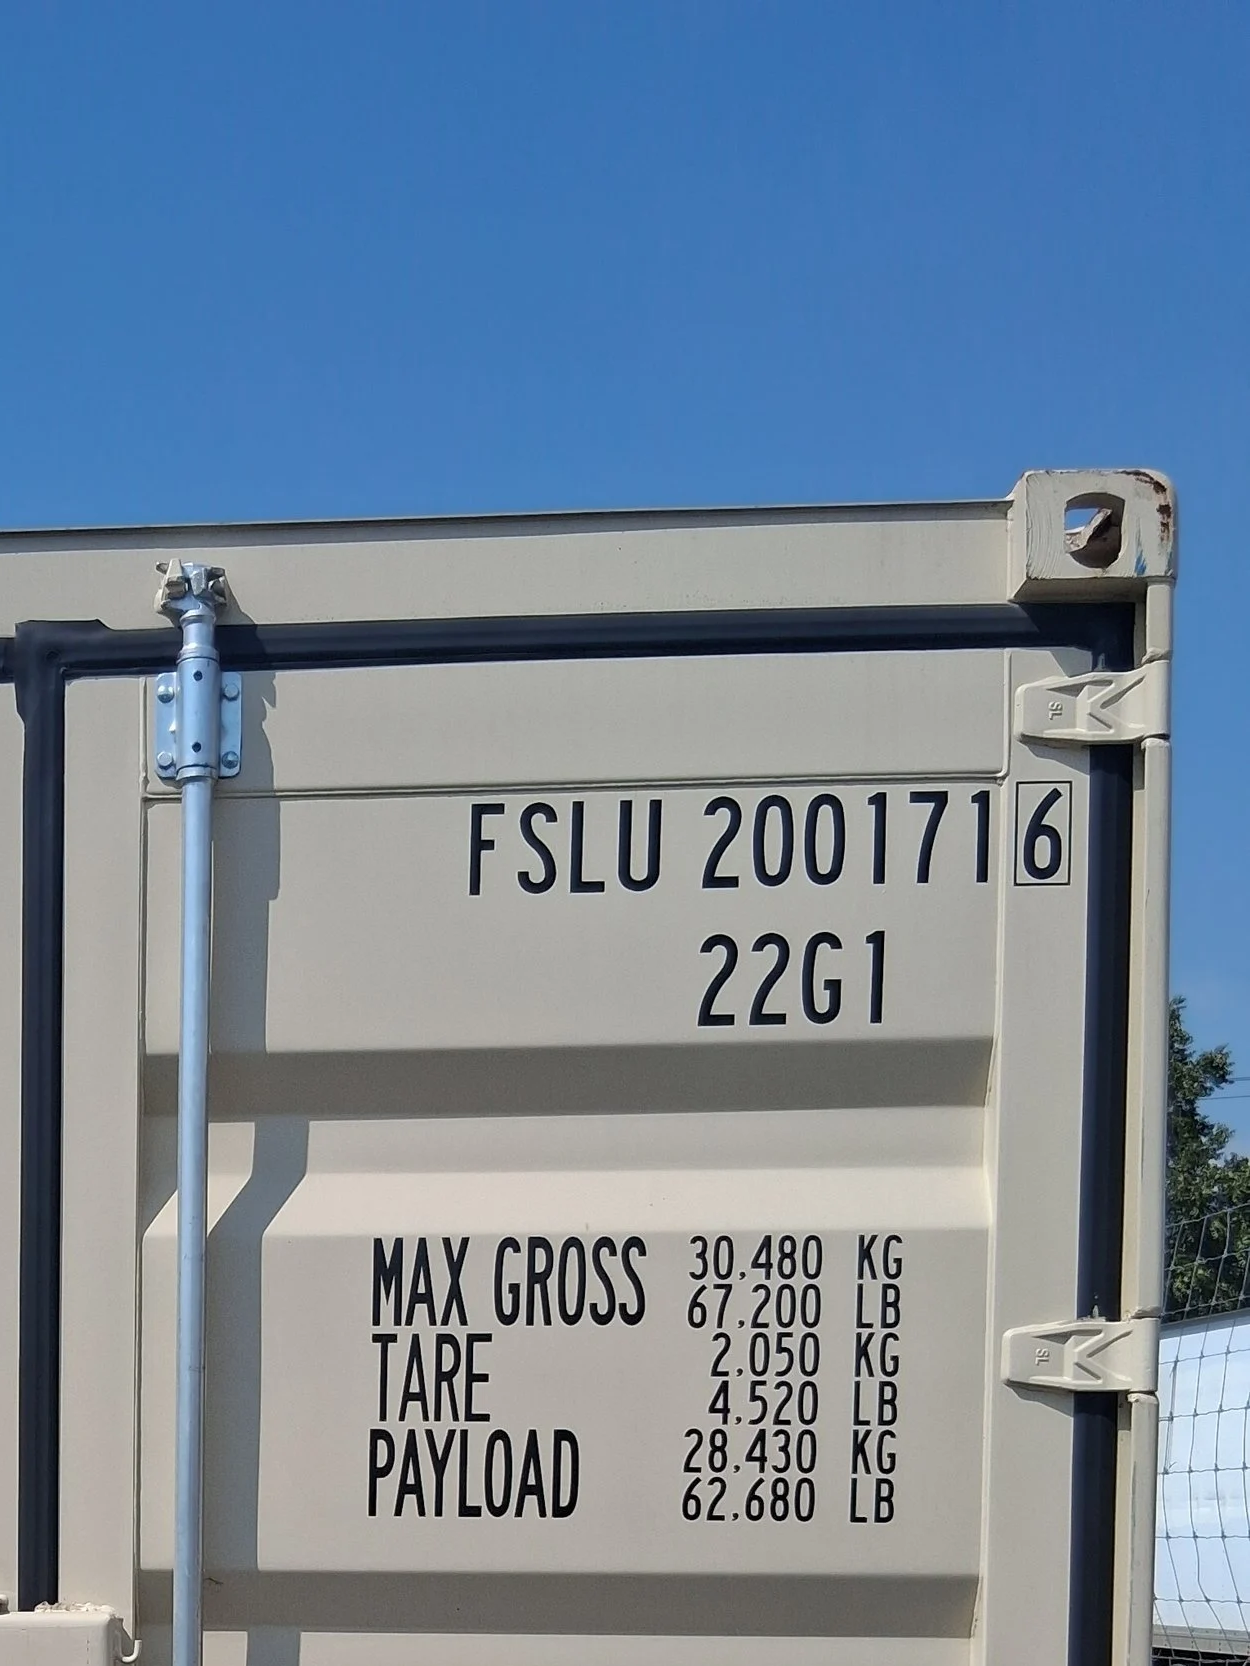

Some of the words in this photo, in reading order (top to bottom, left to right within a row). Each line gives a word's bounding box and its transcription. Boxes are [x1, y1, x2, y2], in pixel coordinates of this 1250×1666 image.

[469, 799, 662, 896] FSLU
[701, 789, 991, 889] 200171
[1023, 787, 1064, 881] 6
[697, 930, 885, 1027] 22G1
[371, 1235, 471, 1327] MAX
[494, 1235, 647, 1327] GROSS
[688, 1234, 823, 1282] 30,480
[856, 1234, 904, 1281] KG
[686, 1282, 823, 1330] 67,200
[855, 1282, 902, 1330] LB
[371, 1332, 493, 1423] TARE
[709, 1331, 821, 1379] 2,050
[853, 1331, 900, 1379] KG
[707, 1379, 819, 1427] 4,520
[853, 1379, 899, 1427] LB
[366, 1428, 580, 1518] PAYLOAD
[682, 1427, 818, 1475] 28,430
[849, 1427, 897, 1475] KG
[681, 1476, 816, 1523] 62,680
[848, 1476, 896, 1524] LB
